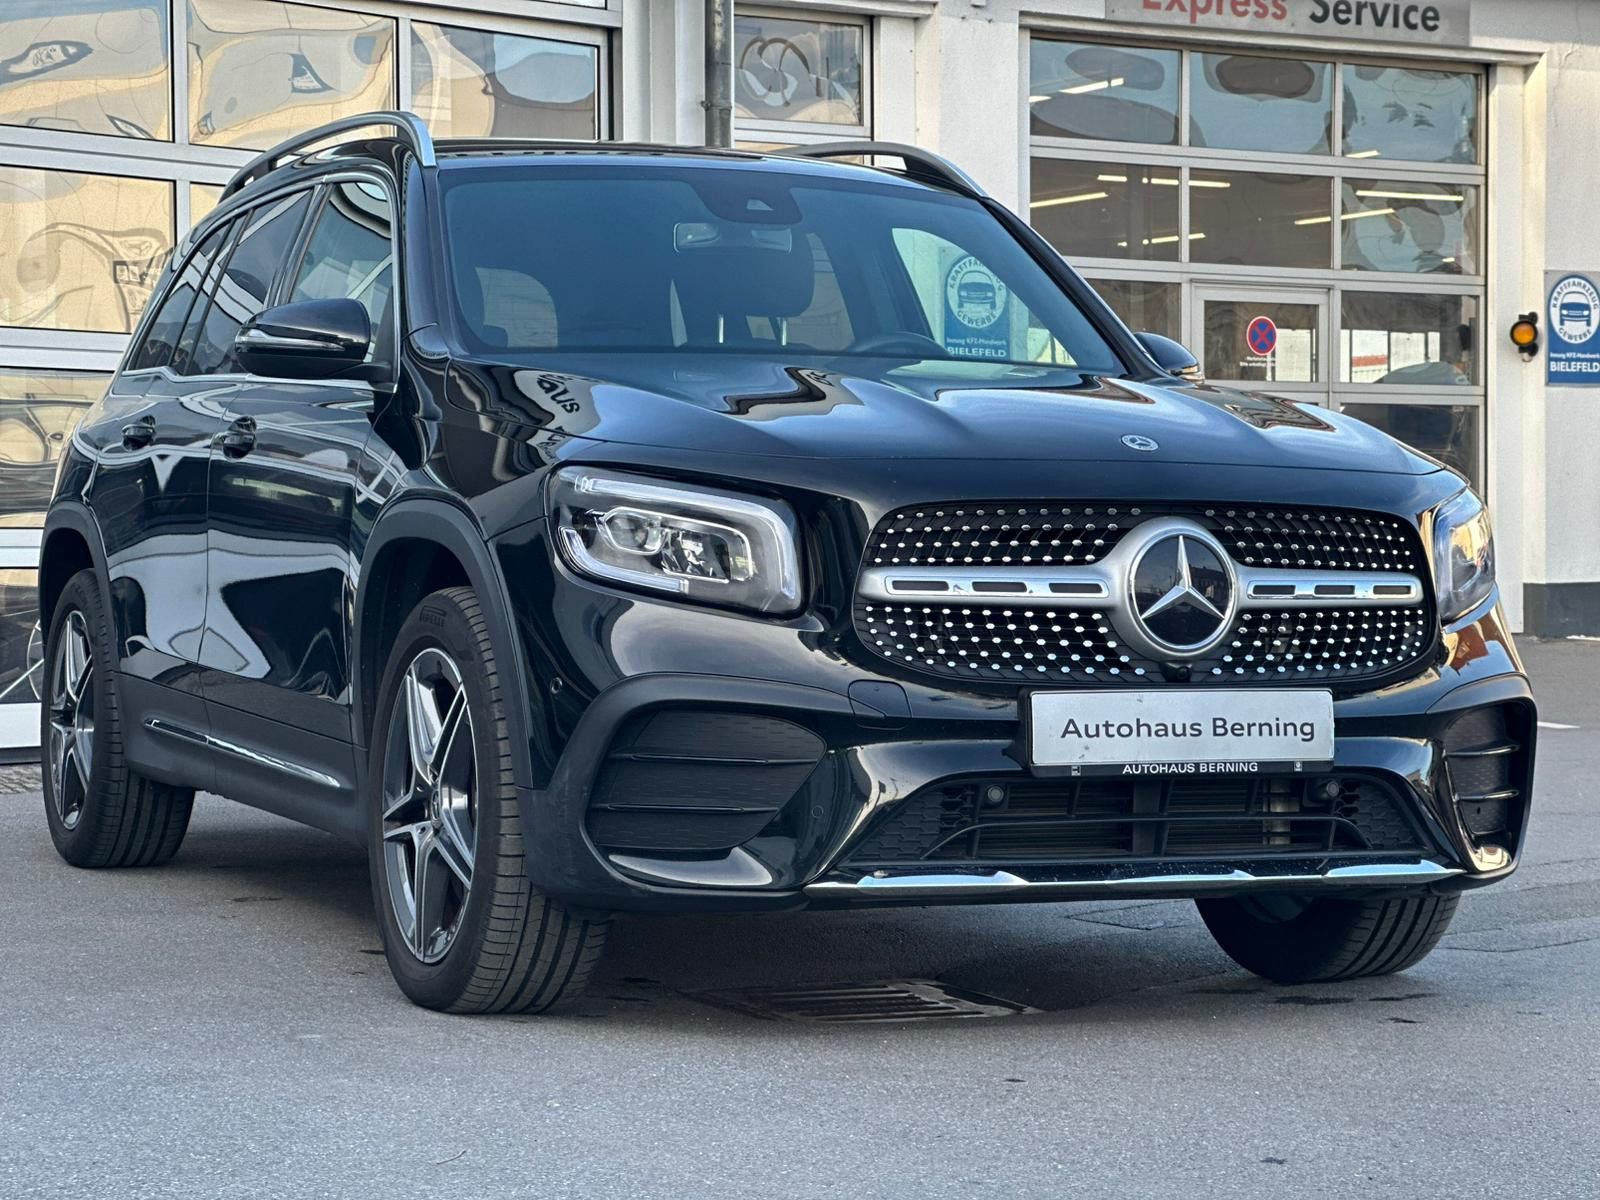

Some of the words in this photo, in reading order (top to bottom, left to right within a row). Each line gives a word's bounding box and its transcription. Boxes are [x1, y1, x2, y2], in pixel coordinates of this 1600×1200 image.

[1309, 0, 1440, 32] Service
[957, 310, 997, 327] GEWERBE
[947, 346, 1007, 358] BIELEFELD
[1550, 361, 1600, 372] BIELEFELD
[1060, 717, 1202, 739] Autohaus
[1212, 717, 1315, 742] Berning
[1122, 763, 1196, 775] AUTOHAUS
[1199, 762, 1259, 773] BERNING
